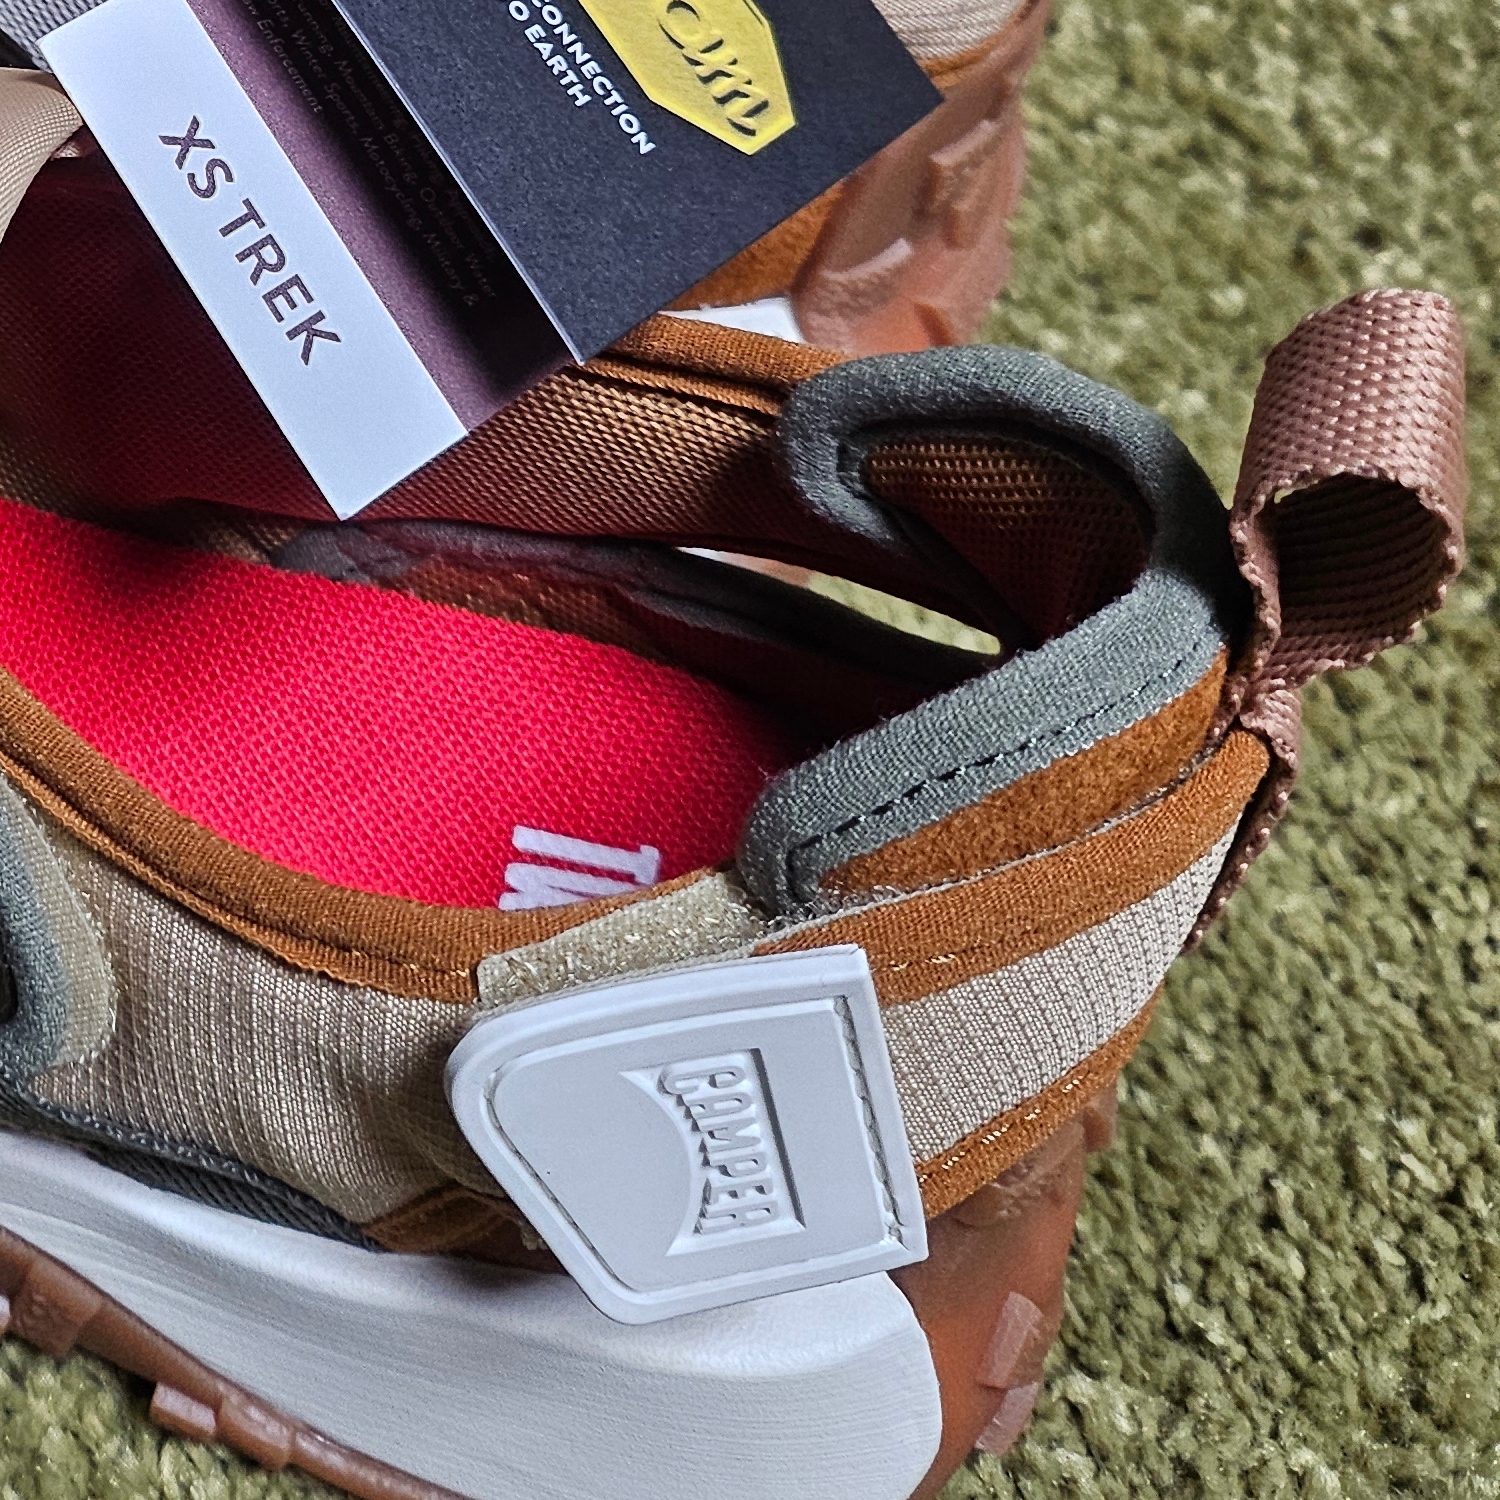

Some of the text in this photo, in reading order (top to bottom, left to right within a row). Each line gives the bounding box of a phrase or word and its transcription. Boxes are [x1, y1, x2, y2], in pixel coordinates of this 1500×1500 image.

[255, 19, 324, 112] Enforcement
[333, 59, 386, 129] Mountain
[524, 24, 592, 107] EARTH
[291, 30, 328, 79] Winter
[462, 291, 480, 306] &
[158, 115, 341, 366] XS TREK
[657, 1064, 781, 1236] CAMPER
